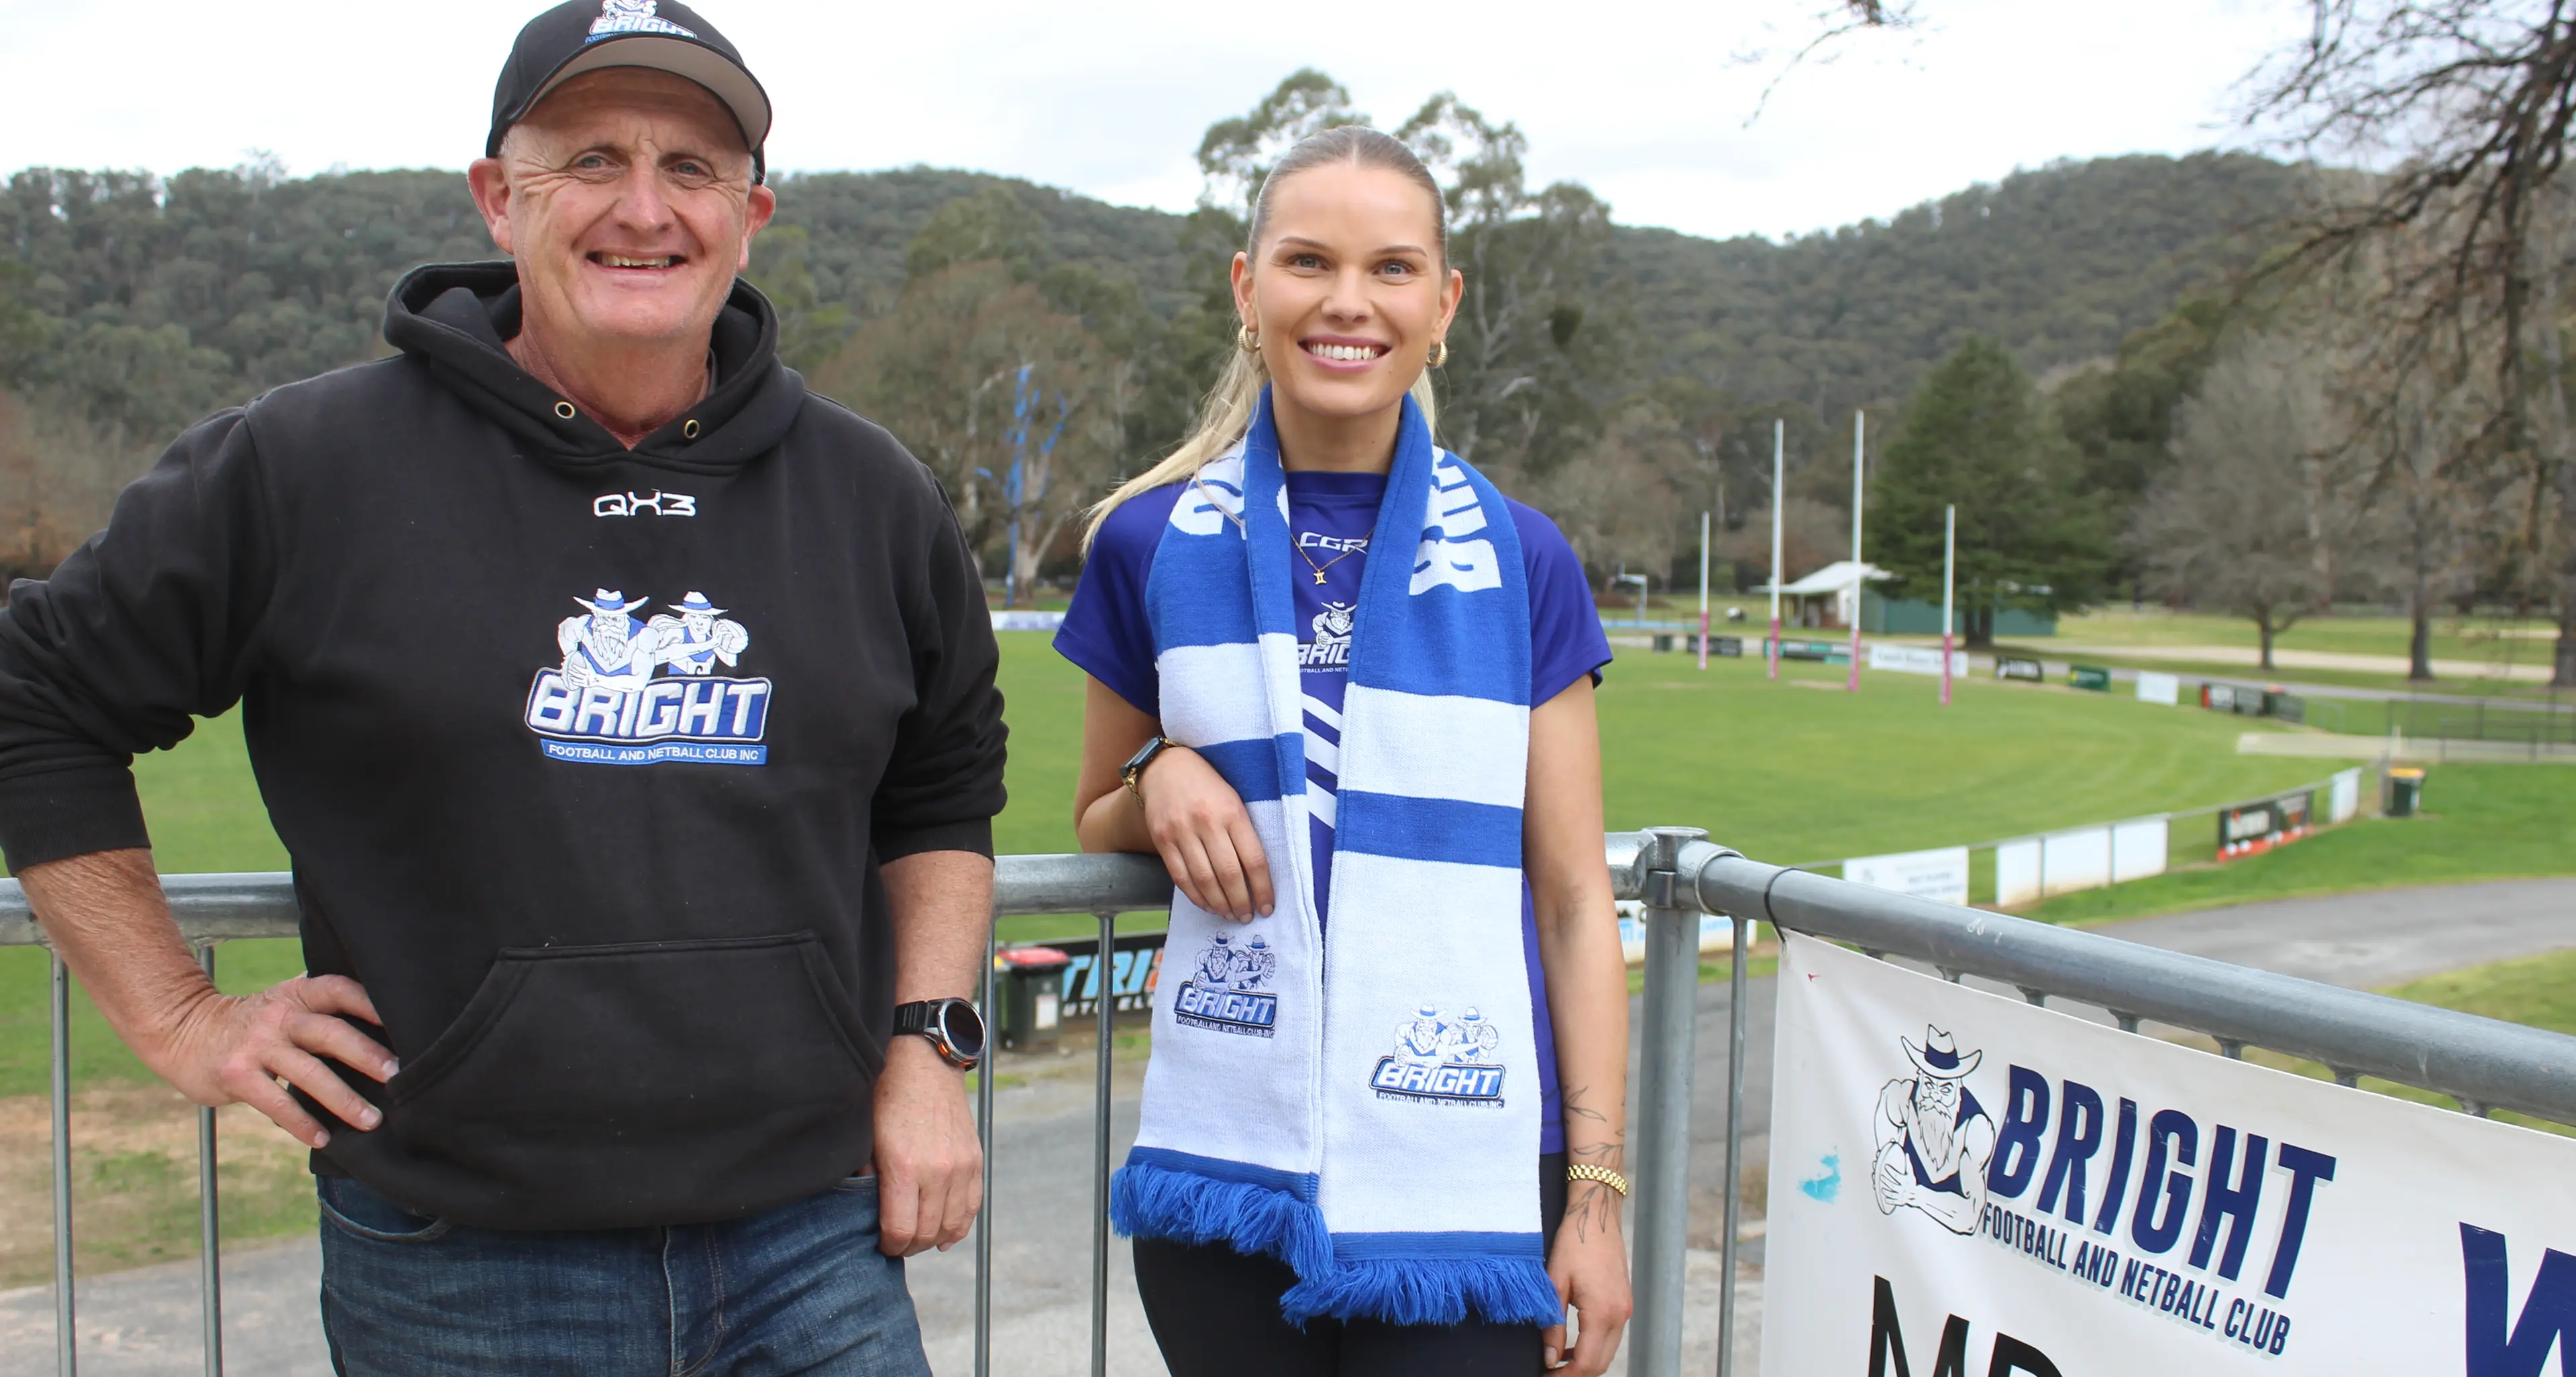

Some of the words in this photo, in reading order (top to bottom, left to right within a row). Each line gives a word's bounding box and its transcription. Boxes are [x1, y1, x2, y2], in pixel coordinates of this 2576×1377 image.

[593, 491, 696, 516] QX3
[1299, 531, 1368, 555] CGR
[529, 673, 767, 738] BRIGHT
[549, 745, 615, 761] FOOTBALL
[619, 750, 645, 761] AND
[647, 747, 704, 760] NETBALL
[705, 749, 737, 759] CLUB
[739, 749, 759, 761] INC
[1179, 987, 1275, 1024] BRIGHT
[1178, 1015, 1210, 1030] FOOTBALL
[1208, 1022, 1222, 1031] AND
[1222, 1024, 1246, 1034] NETBALL
[1247, 1028, 1263, 1036] CLUB
[1263, 1029, 1275, 1038] INC
[1377, 1062, 1500, 1095] BRIGHT
[1379, 1092, 1419, 1105] FOOTBALL
[1418, 1097, 1436, 1106] AND
[1437, 1097, 1468, 1108] NETBALL
[1469, 1100, 1489, 1108] CLUB
[1489, 1100, 1503, 1109] INC
[1986, 1063, 2337, 1300] BRIGHT
[1982, 1201, 2068, 1271] FOOTBALL
[2073, 1240, 2118, 1288] AND
[2120, 1257, 2218, 1331] NETBALL
[2224, 1297, 2292, 1356] CLUB
